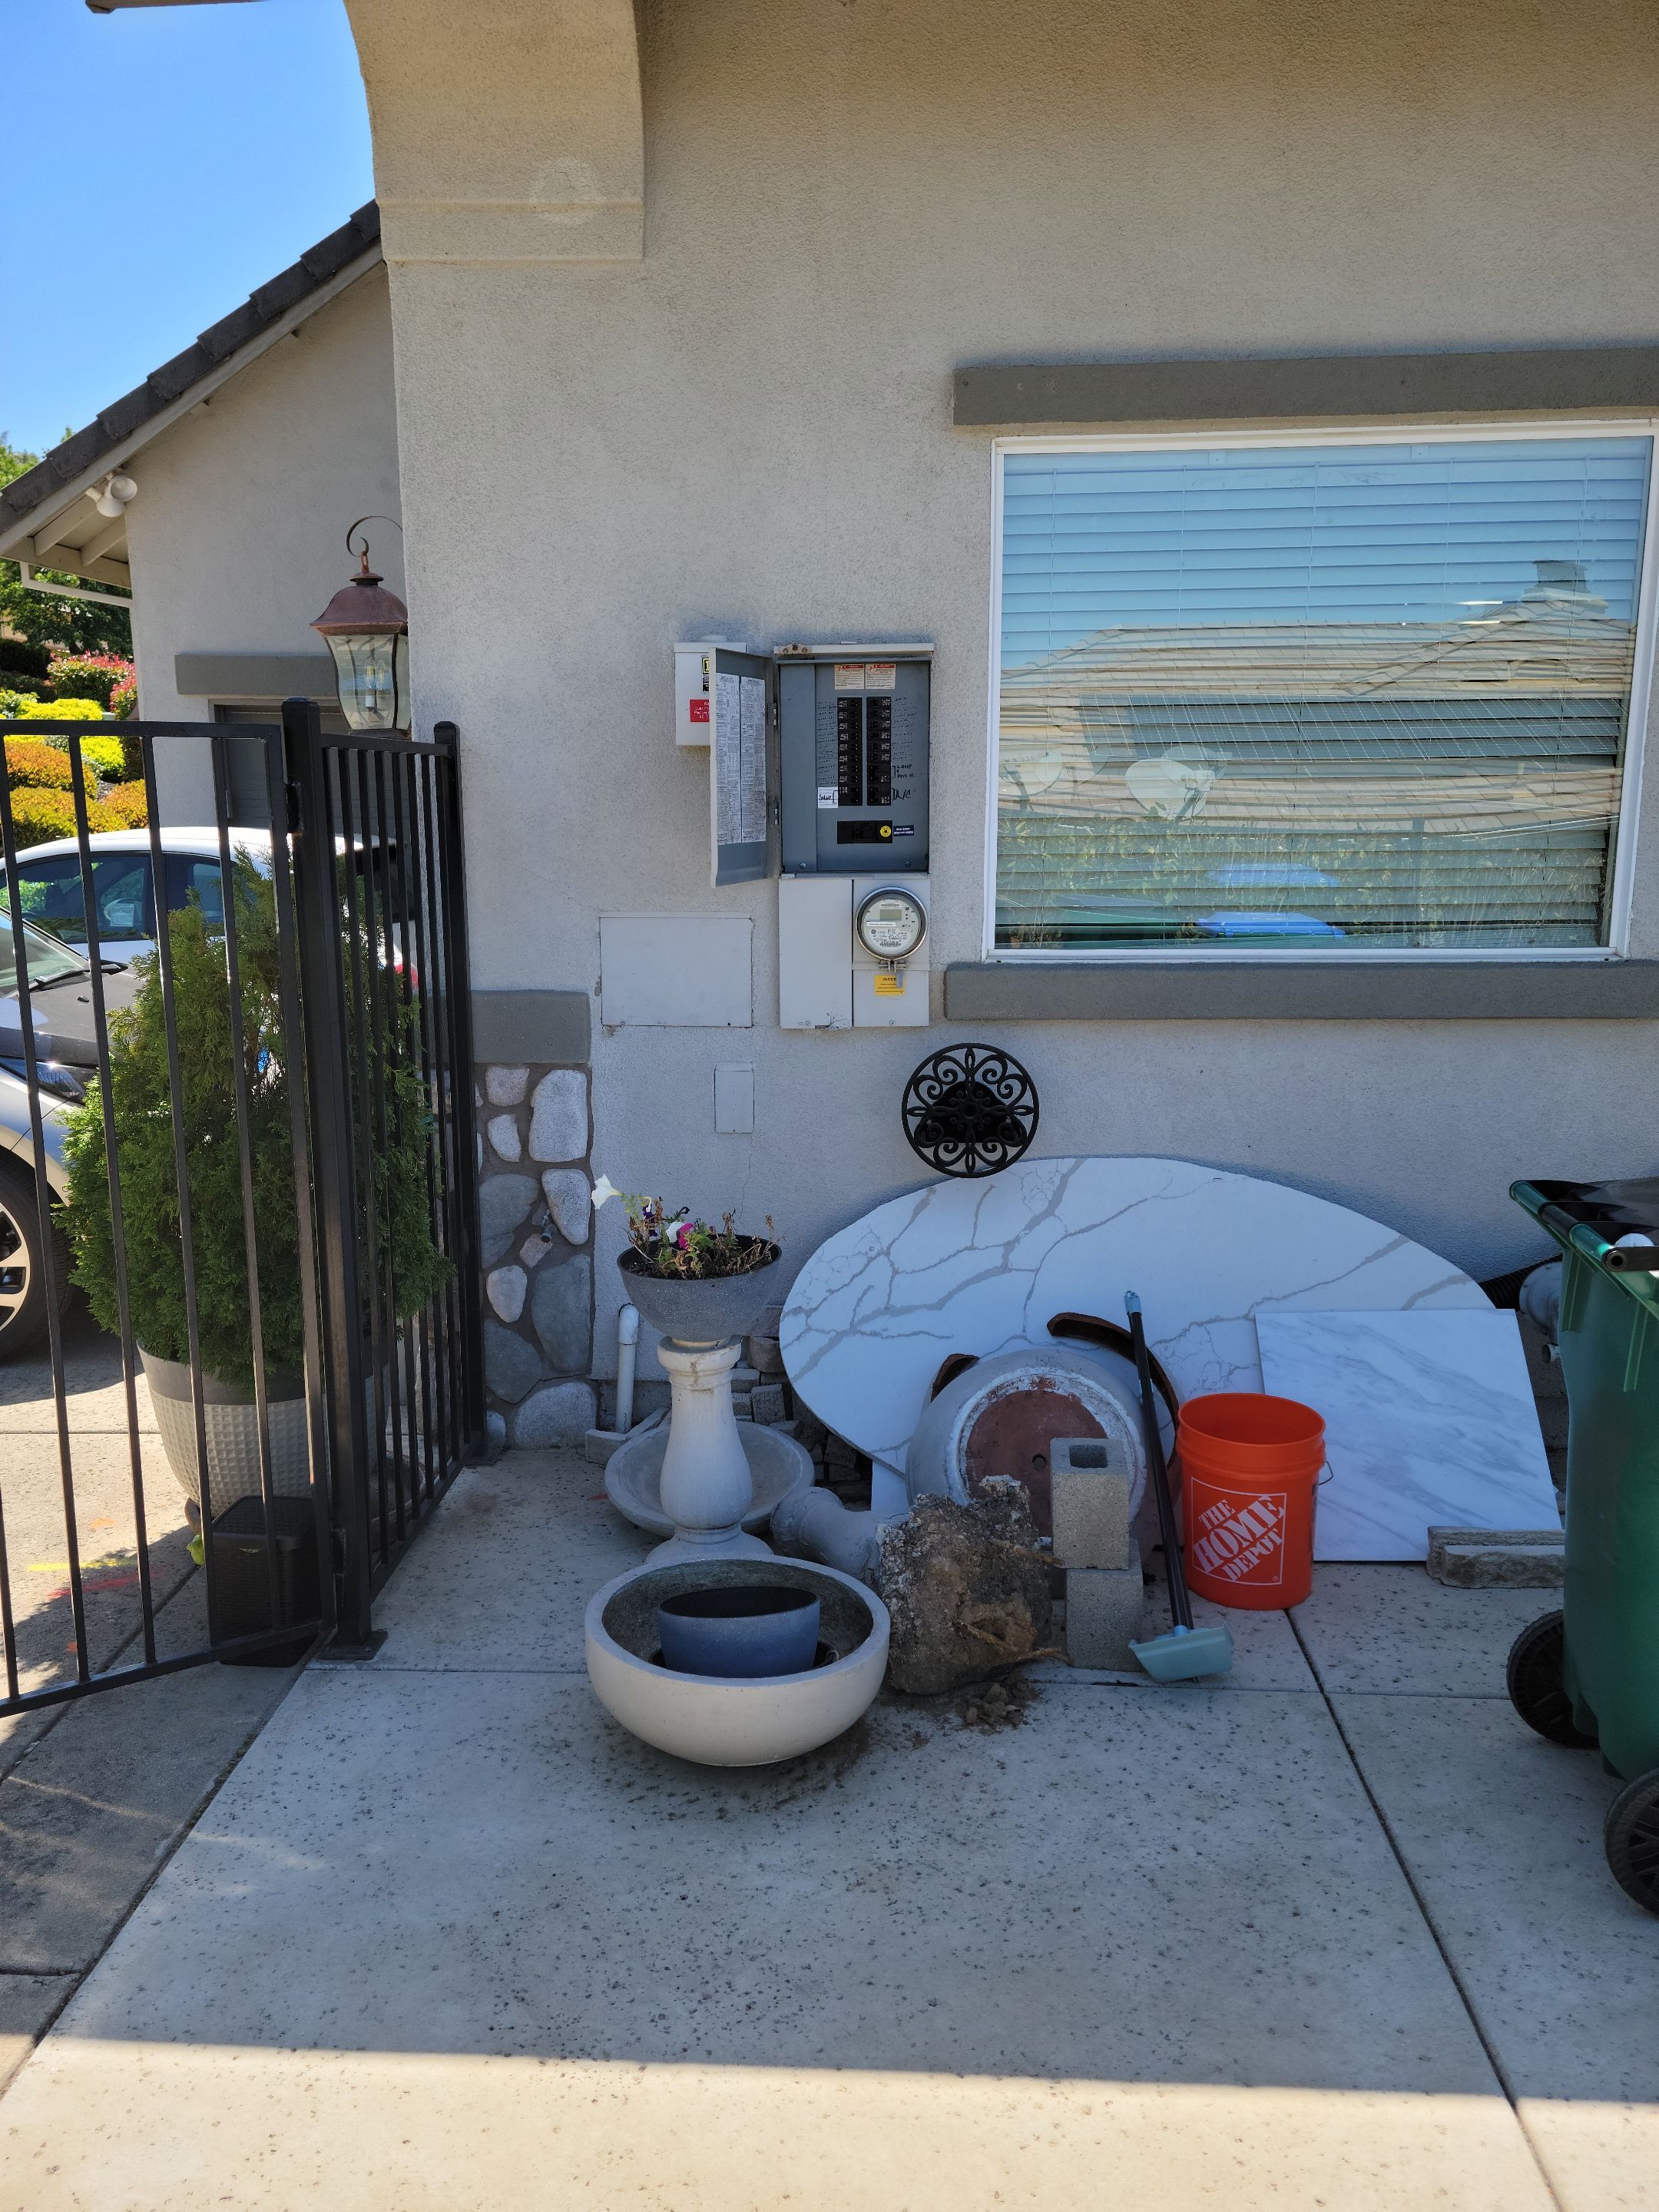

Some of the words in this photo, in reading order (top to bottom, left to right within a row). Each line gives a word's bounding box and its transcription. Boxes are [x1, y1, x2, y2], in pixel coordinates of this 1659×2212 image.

[1192, 1495, 1286, 1574] HOME
[1198, 1499, 1236, 1531] THE
[1223, 1528, 1283, 1582] DEPOT
